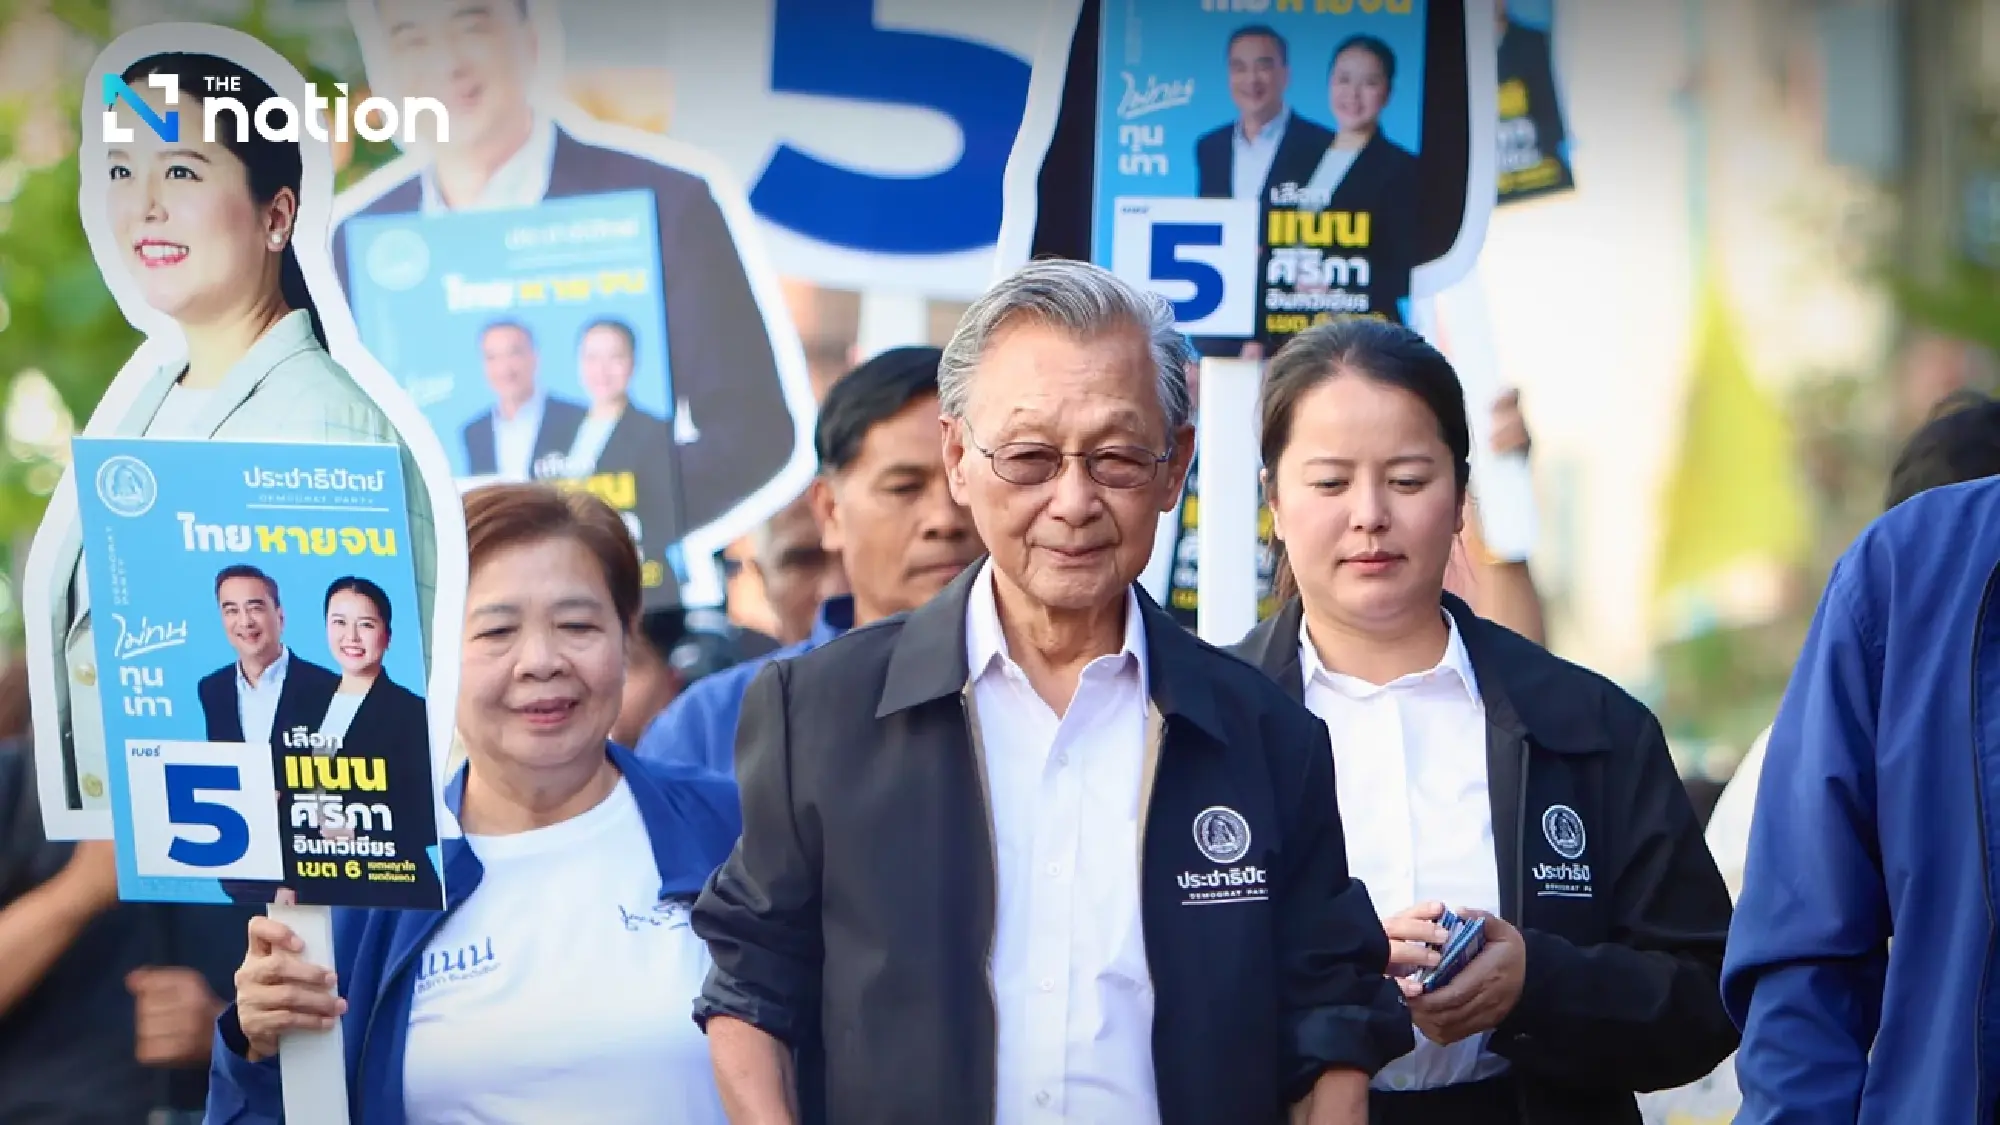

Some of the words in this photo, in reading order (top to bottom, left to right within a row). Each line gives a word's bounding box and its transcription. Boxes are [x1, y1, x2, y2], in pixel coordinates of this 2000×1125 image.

[749, 0, 1033, 255] 5
[1268, 210, 1371, 249] แนน
[1150, 222, 1224, 323] 5
[243, 465, 385, 492] ประชาธิปัตย์
[119, 666, 164, 694] ทุน
[123, 696, 172, 717] เทา
[131, 744, 161, 757] เบอร์
[282, 725, 344, 749] เลือก
[284, 755, 388, 791] แนน
[164, 763, 250, 868] 5
[290, 793, 393, 831] ศิริภา
[293, 834, 396, 857] อินทวิเชียร
[297, 861, 338, 878] เขต
[344, 860, 362, 879] 6
